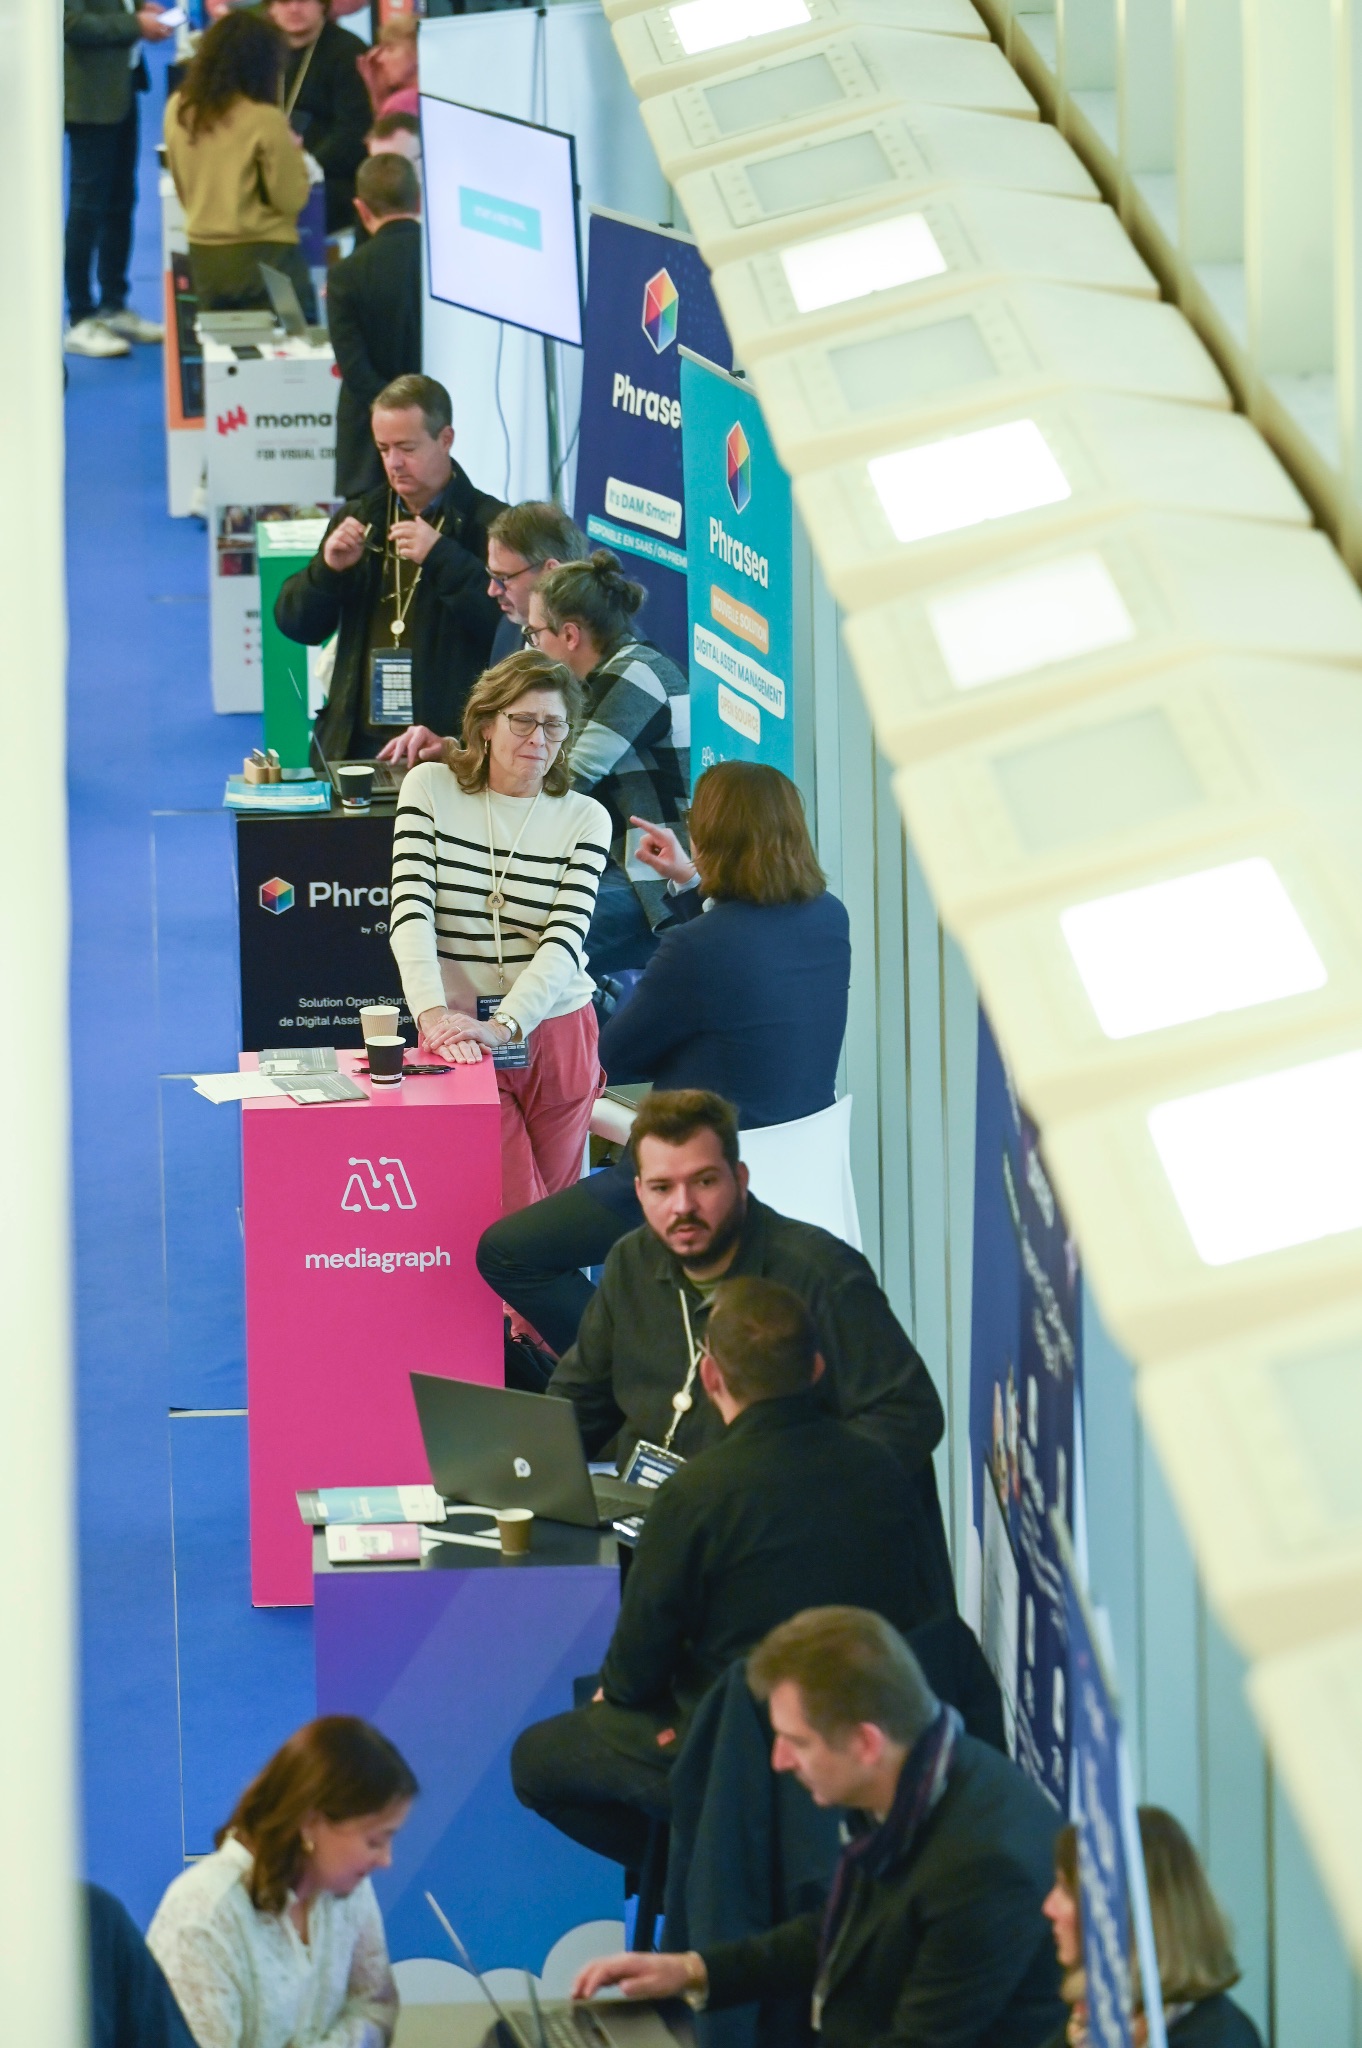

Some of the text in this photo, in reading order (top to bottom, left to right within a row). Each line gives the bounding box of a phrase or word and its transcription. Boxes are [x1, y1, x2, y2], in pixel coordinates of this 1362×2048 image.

[256, 413, 332, 428] moma
[621, 493, 644, 513] DAM
[623, 533, 635, 548] EN
[709, 515, 768, 589] Phrasea
[696, 635, 783, 707] DIGITAL ASSET MANAGEMENT
[309, 882, 391, 907] Phra
[361, 926, 371, 935] by
[299, 997, 344, 1008] Solution
[345, 996, 376, 1009] Open
[279, 1015, 361, 1028] de Digital Asse
[305, 1246, 451, 1274] mediagraph
